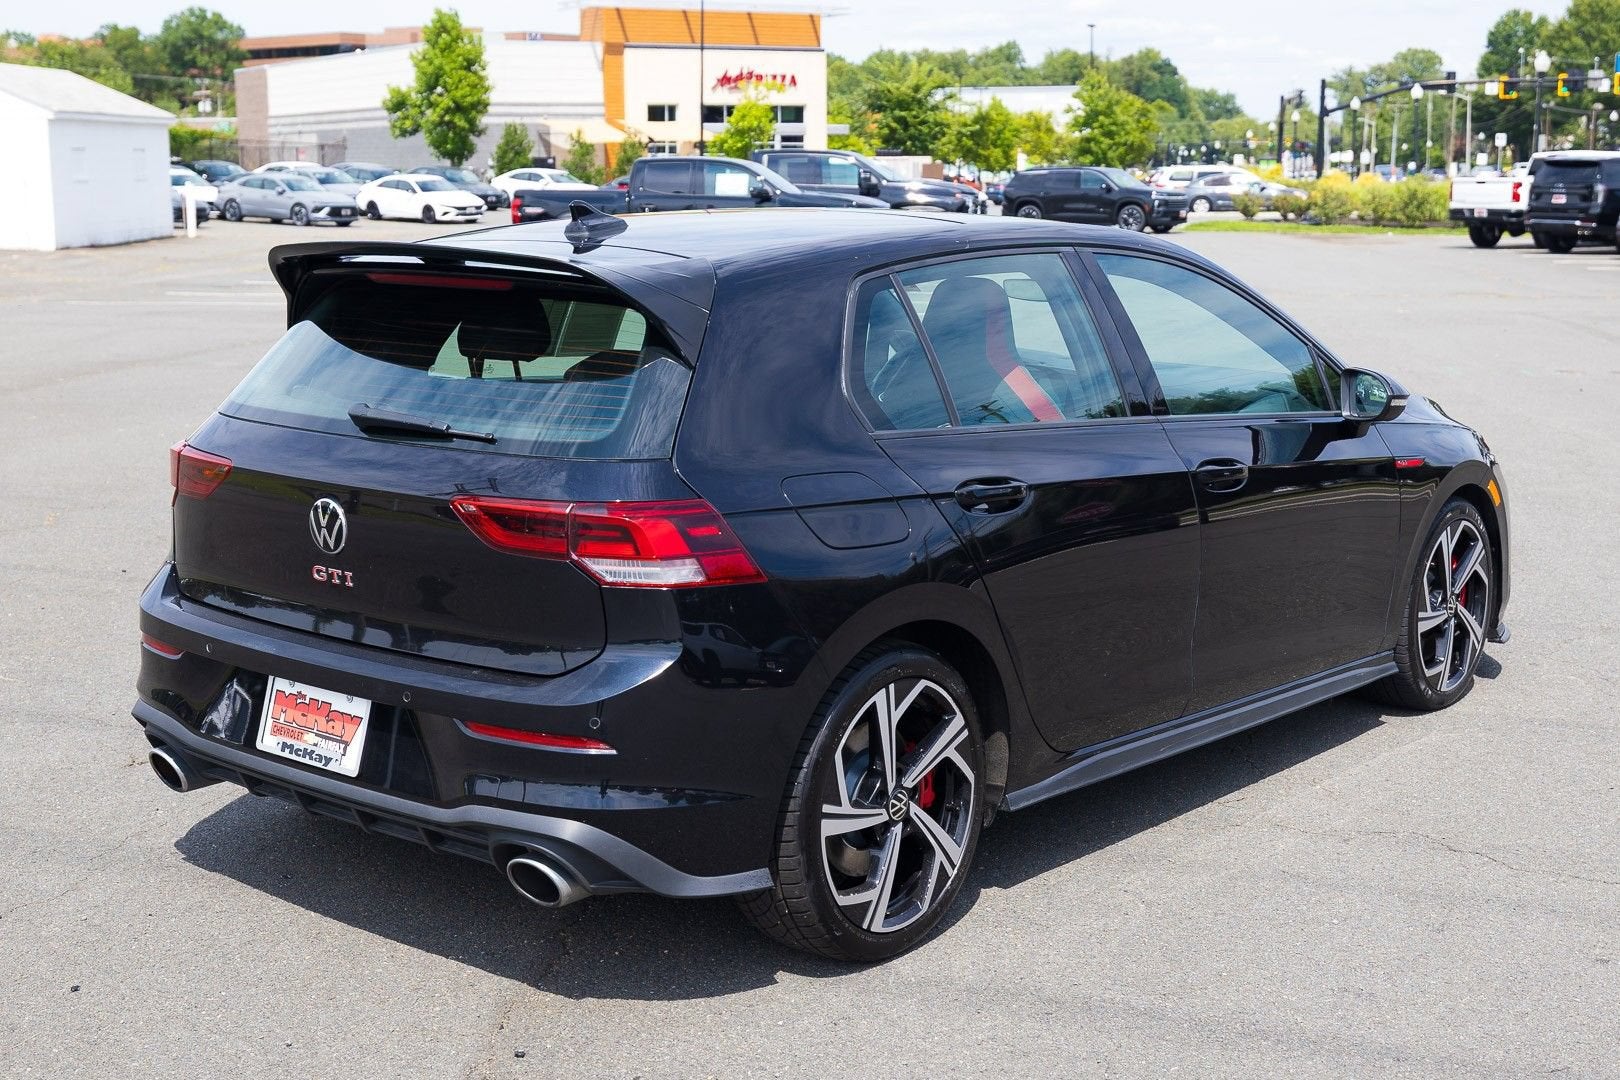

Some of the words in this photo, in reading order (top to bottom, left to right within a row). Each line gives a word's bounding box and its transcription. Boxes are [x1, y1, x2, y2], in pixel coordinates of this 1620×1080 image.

[312, 565, 353, 587] GTI
[271, 689, 363, 746] McKay
[272, 725, 304, 742] CHEVROLET
[281, 741, 333, 767] McKay
